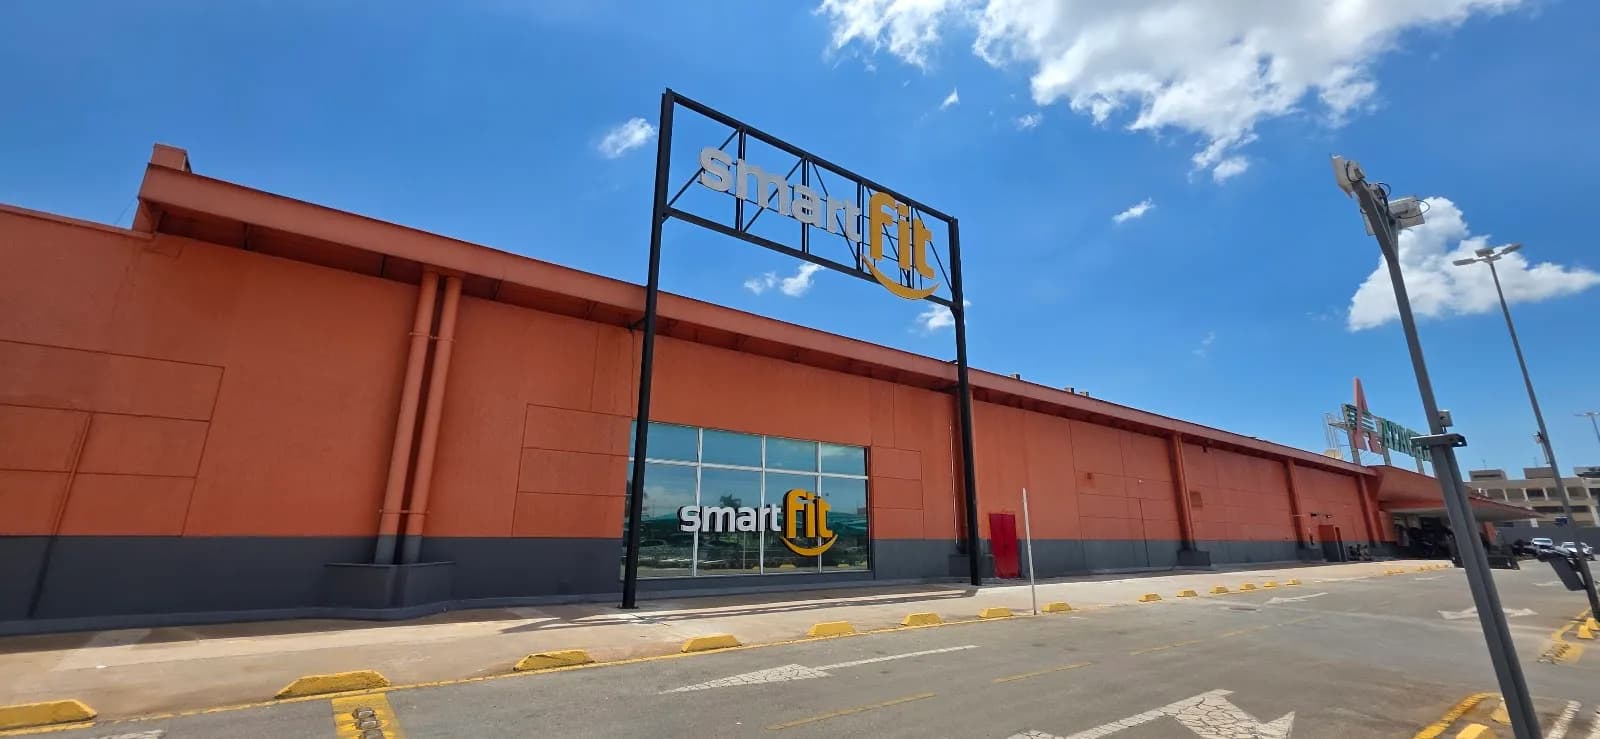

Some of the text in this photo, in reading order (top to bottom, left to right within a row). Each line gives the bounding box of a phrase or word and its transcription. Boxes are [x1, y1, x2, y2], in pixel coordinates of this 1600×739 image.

[699, 147, 935, 279] smart fit
[680, 488, 833, 539] smart fit
